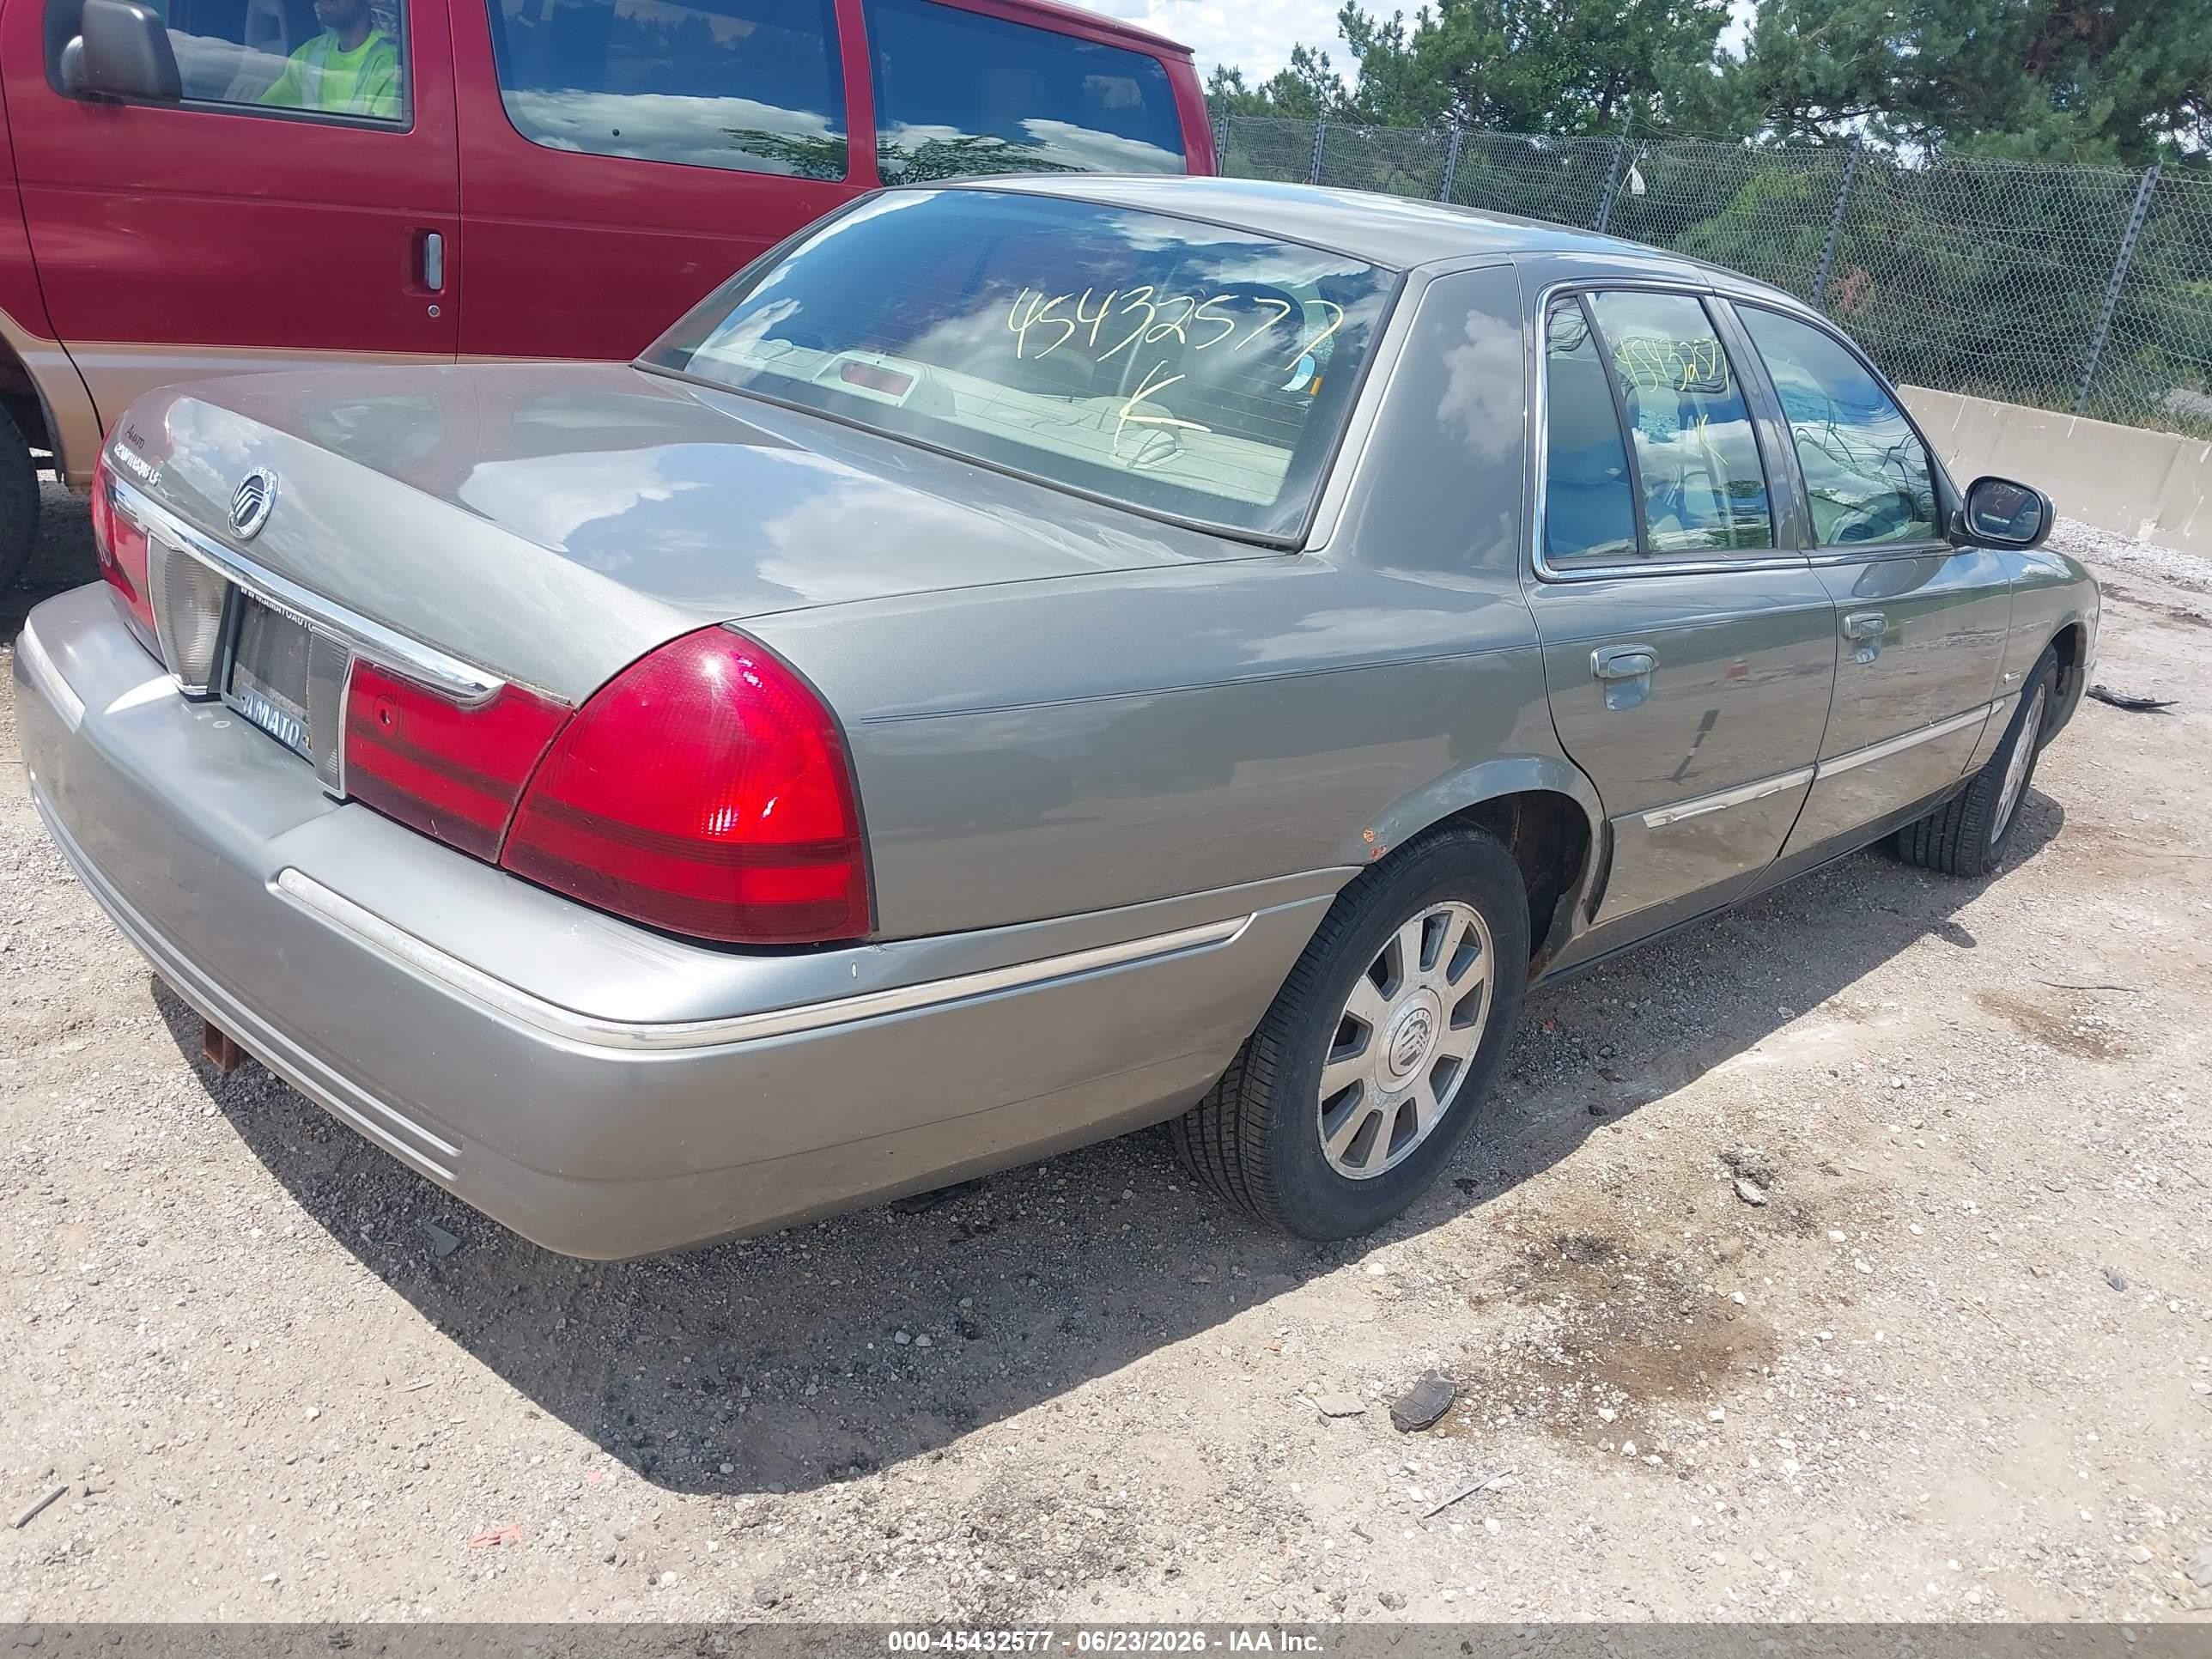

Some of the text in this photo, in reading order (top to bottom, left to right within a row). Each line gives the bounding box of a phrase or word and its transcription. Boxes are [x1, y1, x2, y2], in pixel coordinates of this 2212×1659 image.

[1007, 286, 1345, 371] 45432577
[1113, 359, 1212, 457] K
[1695, 413, 1729, 465] K
[242, 694, 301, 748] AMATO
